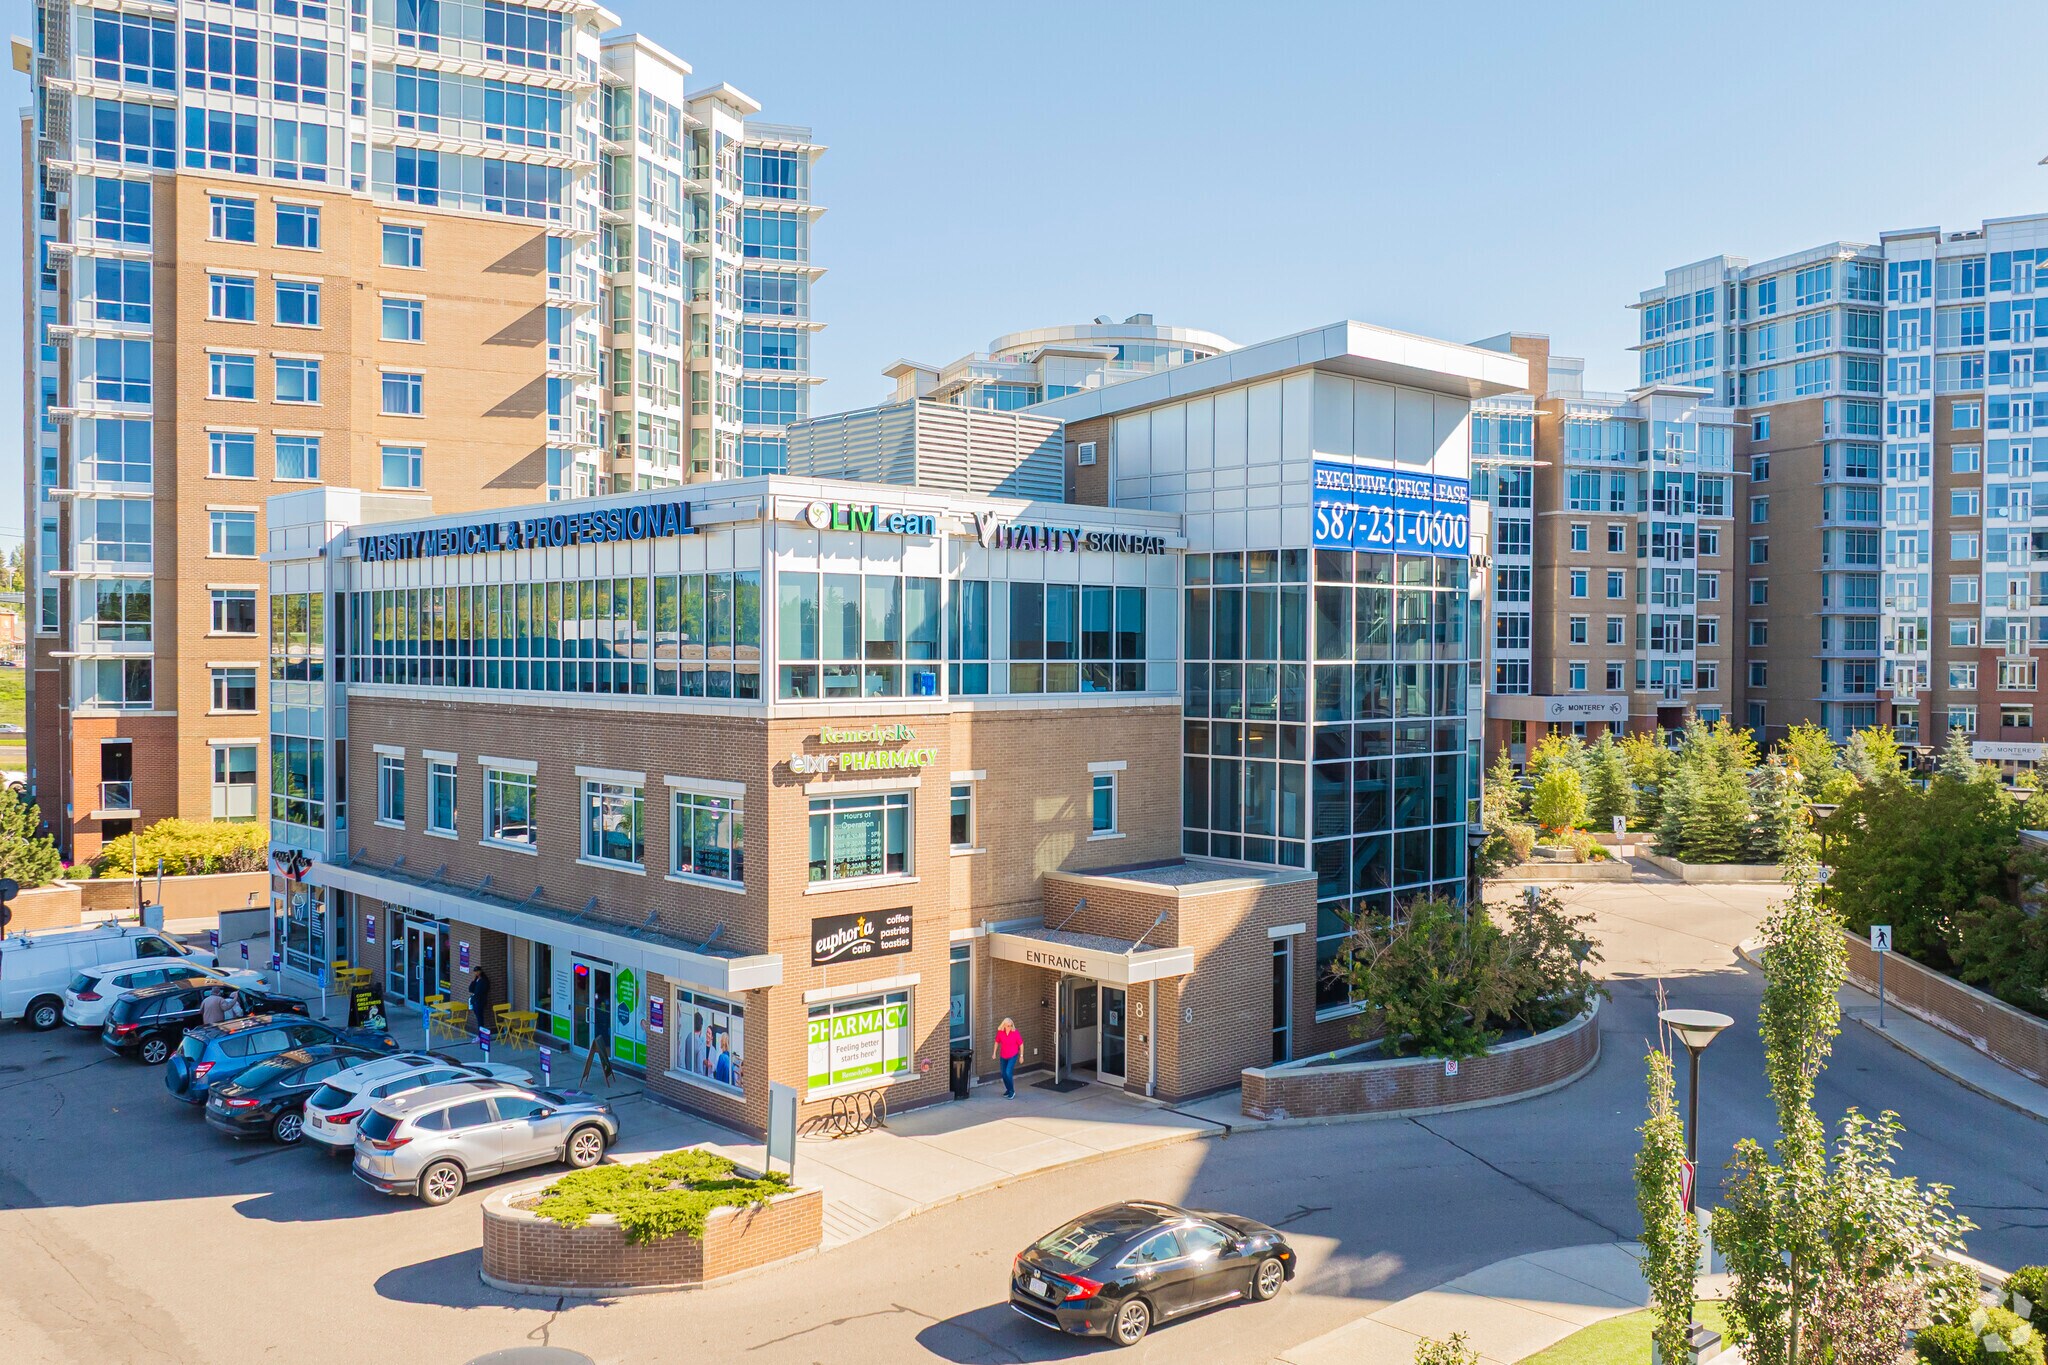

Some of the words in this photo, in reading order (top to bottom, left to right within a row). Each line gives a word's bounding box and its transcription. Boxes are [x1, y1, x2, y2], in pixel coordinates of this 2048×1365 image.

[1316, 470, 1386, 494] EXECUTIVE
[1389, 478, 1431, 500] OFFICE
[1433, 483, 1467, 504] LEASE
[830, 502, 936, 535] LivLean
[1316, 501, 1467, 548] 587-231-0600
[358, 530, 424, 562] VARSITY
[424, 522, 500, 558] MEDICAL
[505, 521, 520, 551] &
[524, 501, 698, 548] PROFESSIONAL
[971, 511, 1083, 553] VITALITY
[1087, 532, 1130, 553] SKIN
[1130, 535, 1166, 555] BAR
[840, 748, 937, 771] PHARMACY
[841, 821, 874, 829] Operation
[1819, 871, 1827, 879] 10
[886, 914, 910, 924] coffee
[815, 917, 874, 953] euphoria
[880, 926, 910, 939] pastries
[852, 943, 871, 955] cafe
[881, 938, 910, 949] toasties
[1026, 950, 1087, 972] ENTRANCE
[1135, 1002, 1144, 1018] 8
[1185, 1007, 1193, 1023] 8
[808, 1008, 906, 1042] PHARMACY
[836, 1043, 859, 1053] Feeling
[861, 1039, 879, 1048] better
[841, 1054, 859, 1062] starts
